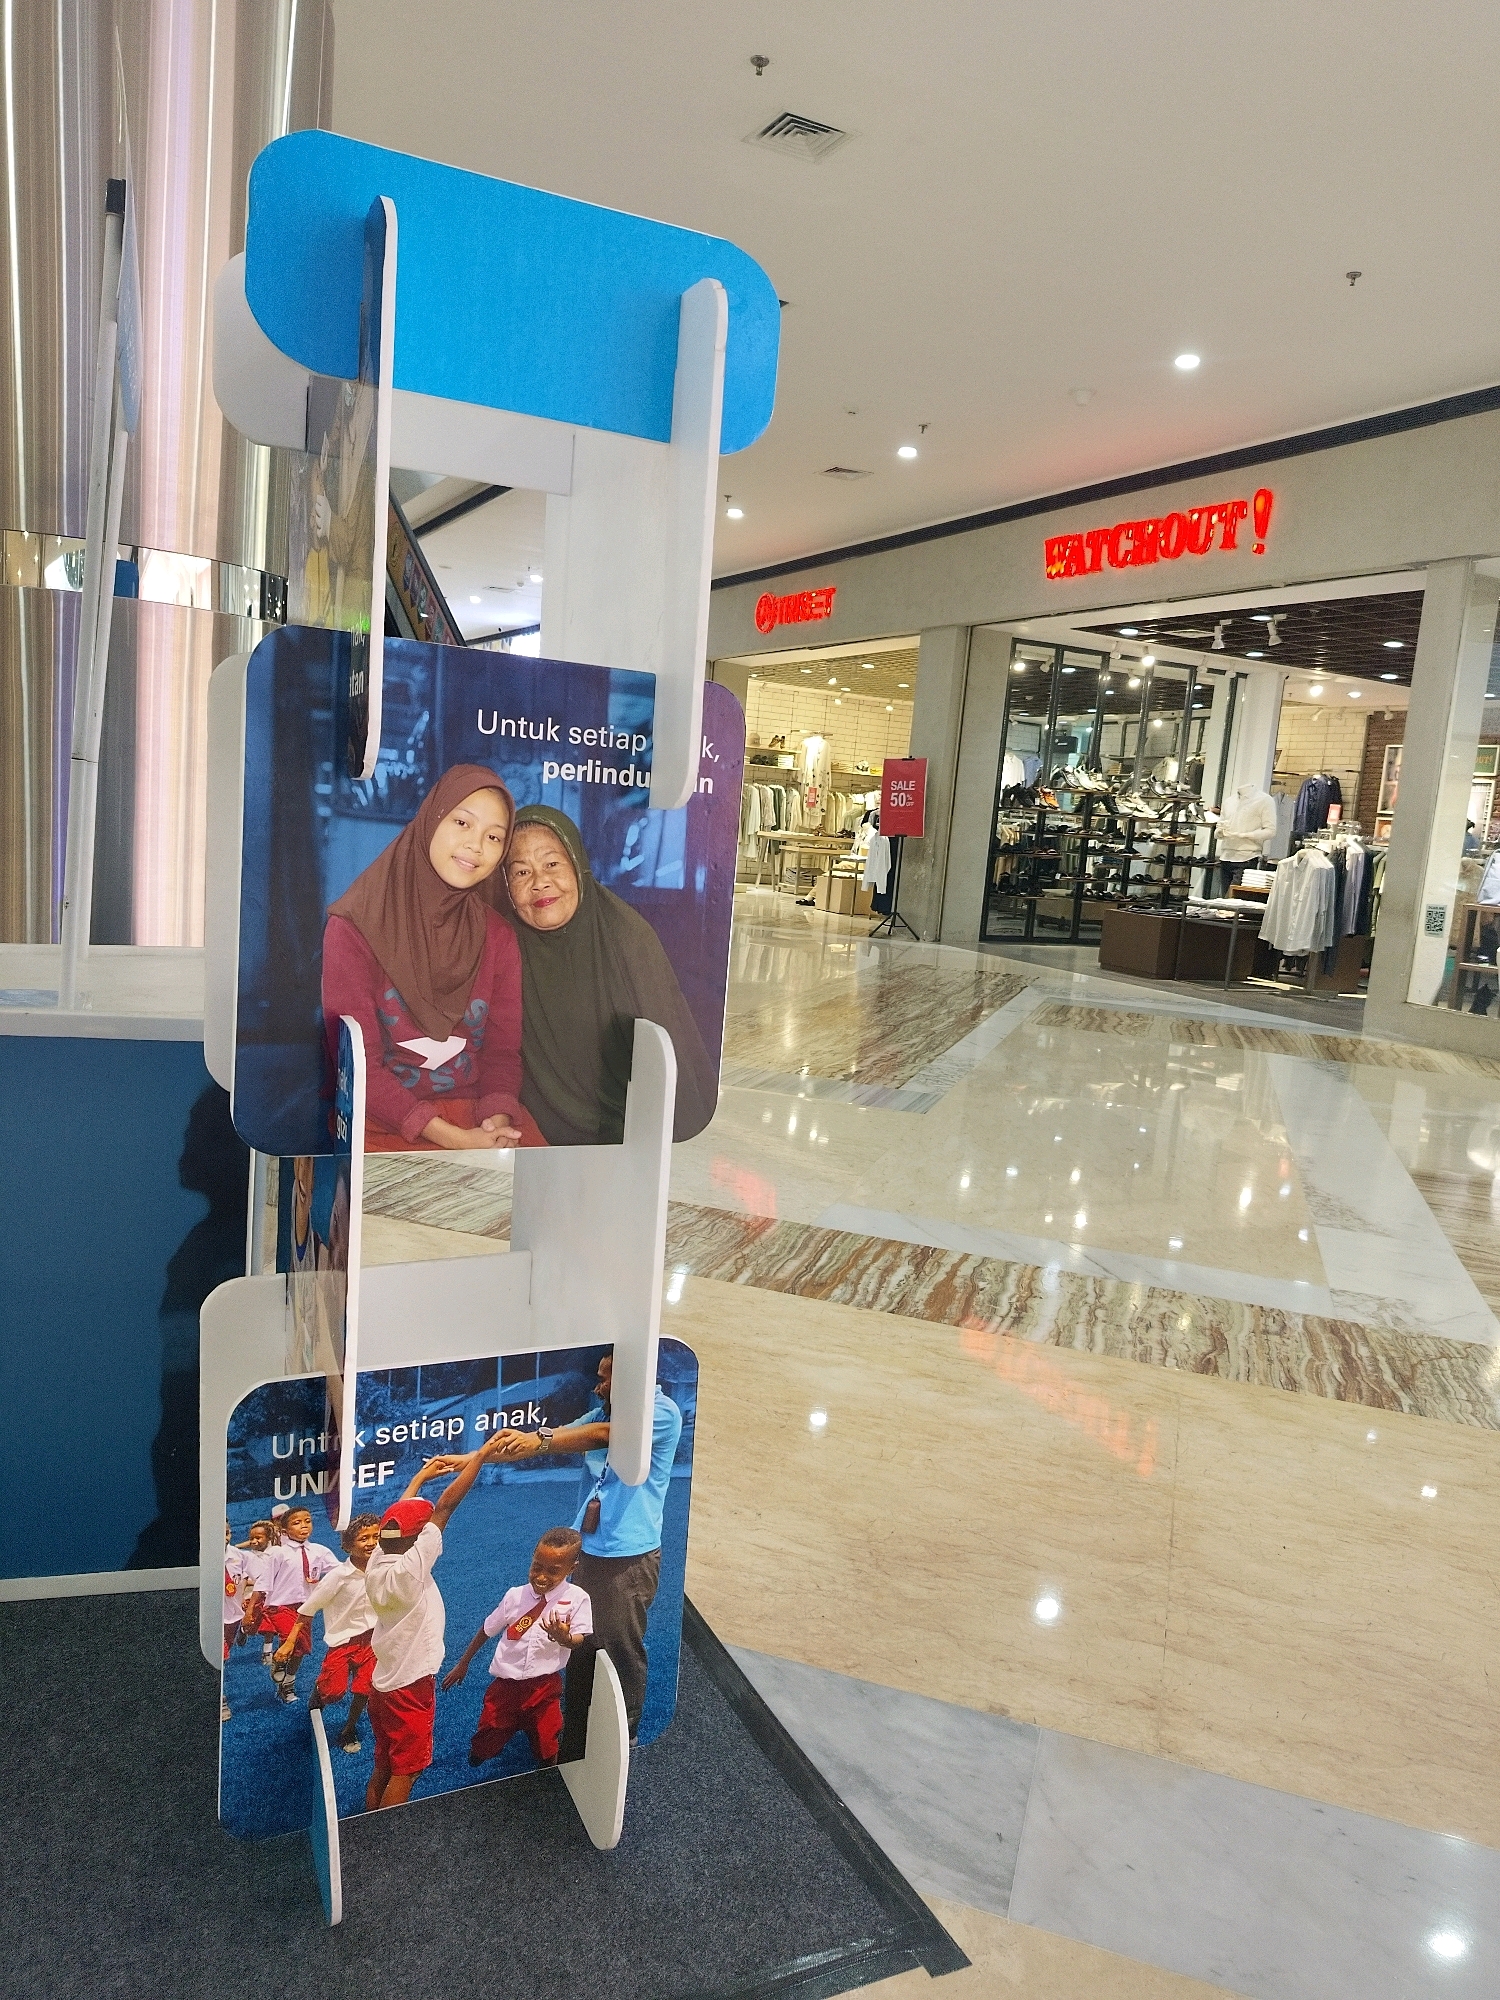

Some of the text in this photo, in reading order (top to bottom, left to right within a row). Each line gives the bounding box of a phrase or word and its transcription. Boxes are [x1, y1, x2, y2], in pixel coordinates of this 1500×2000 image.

[1045, 488, 1274, 580] WATCHOUT!
[476, 708, 648, 757] Untuk setiap
[542, 759, 714, 796] perlindun
[890, 780, 916, 791] SALE
[271, 1401, 549, 1459] Untk setiap anak,
